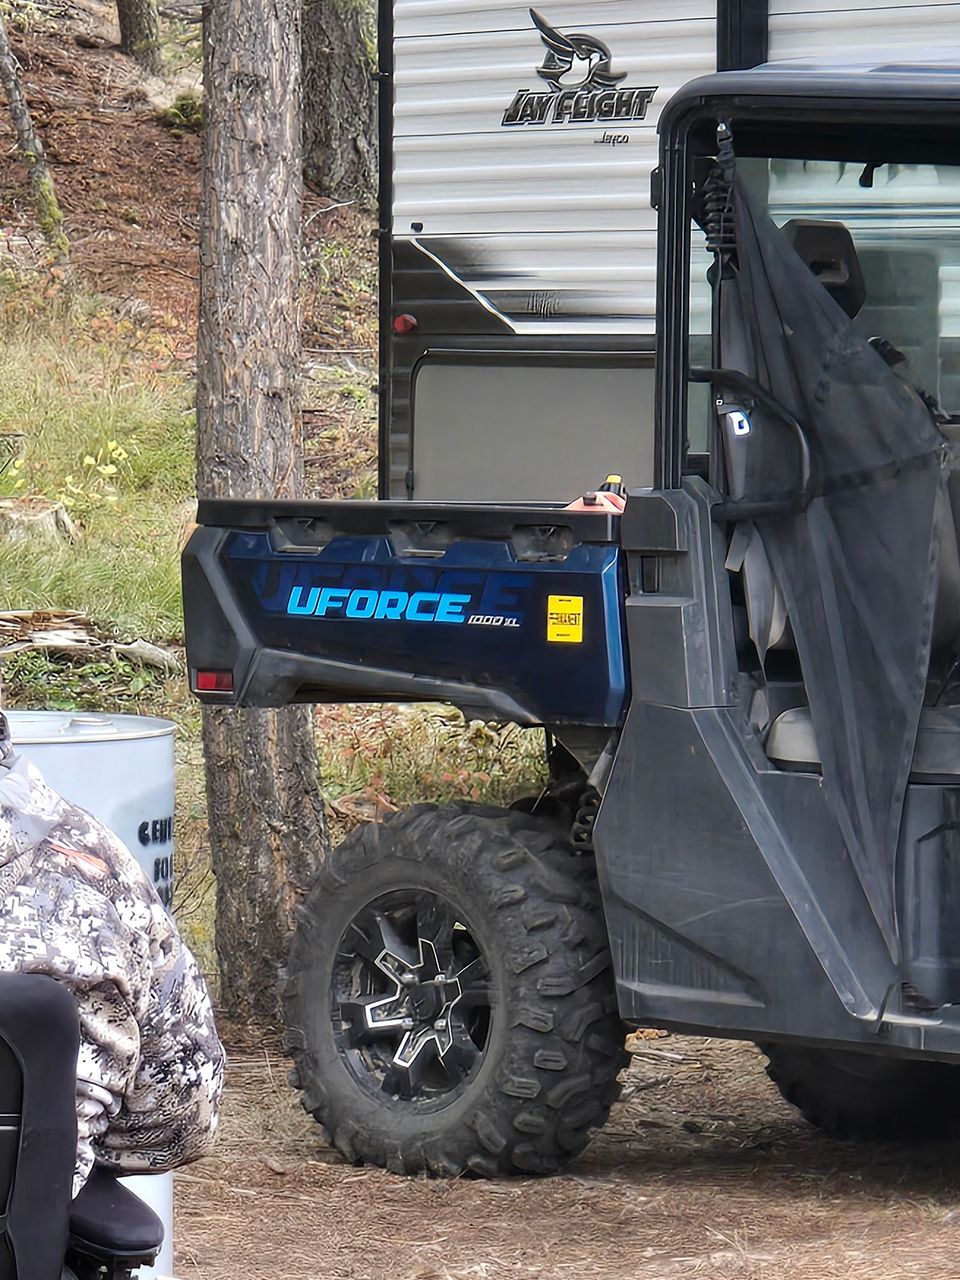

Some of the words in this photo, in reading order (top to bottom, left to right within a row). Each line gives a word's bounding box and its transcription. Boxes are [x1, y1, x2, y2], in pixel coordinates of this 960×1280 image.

[501, 89, 556, 126] JAY
[287, 586, 471, 624] UFORCE
[468, 614, 504, 626] 1000
